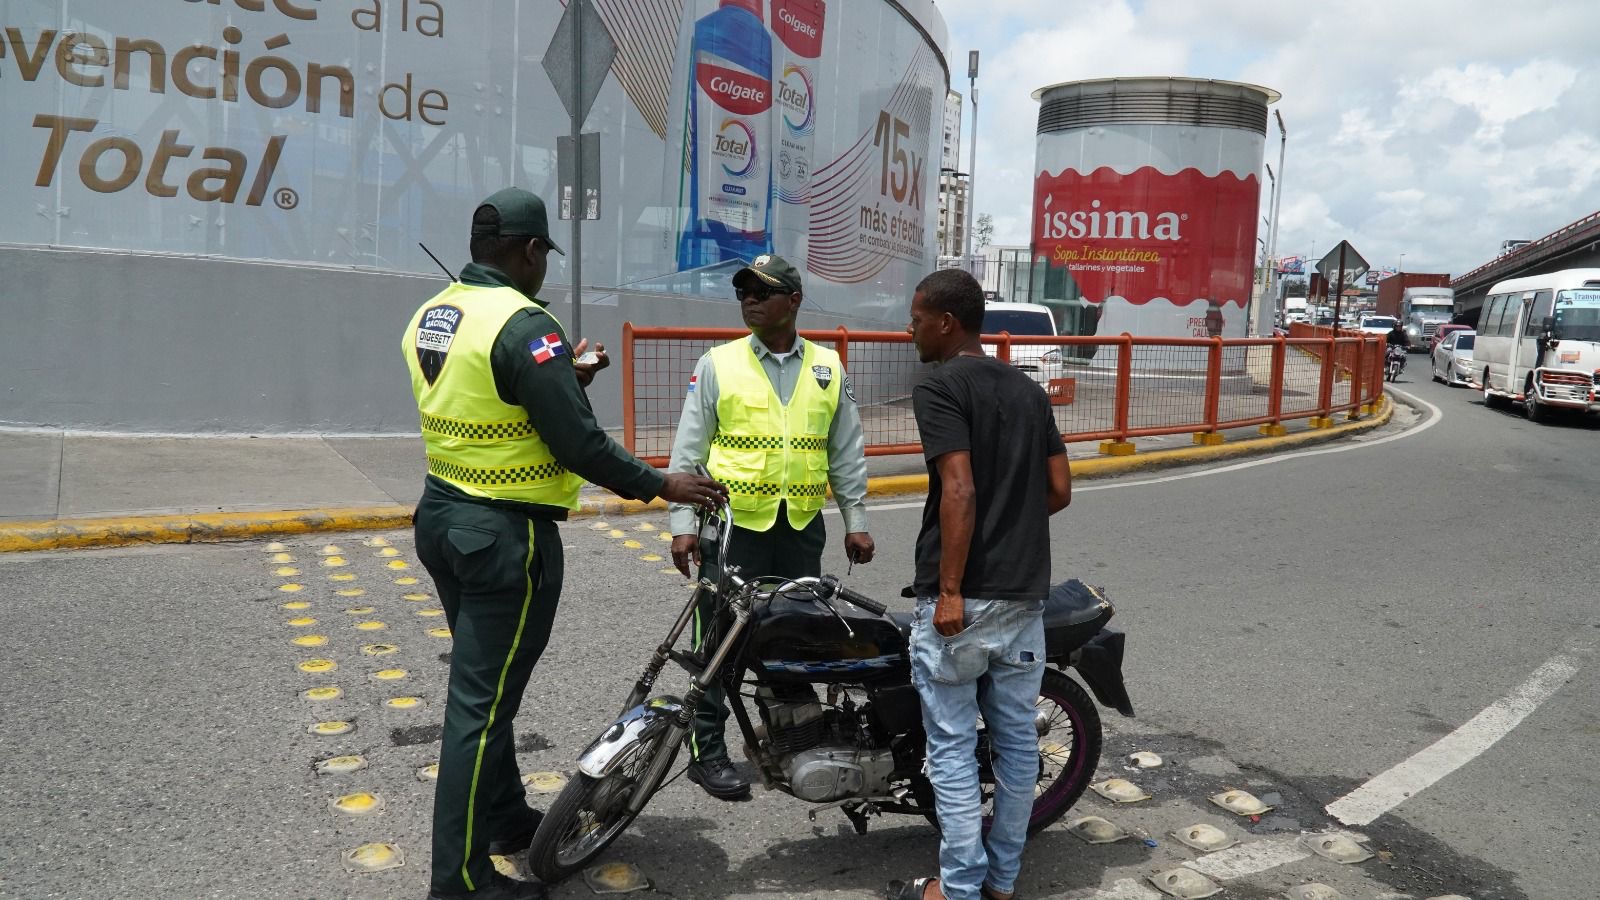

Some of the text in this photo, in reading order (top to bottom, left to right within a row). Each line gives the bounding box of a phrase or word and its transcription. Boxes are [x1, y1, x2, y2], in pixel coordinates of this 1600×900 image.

[401, 0, 444, 38] la
[778, 8, 817, 39] Colgate
[0, 26, 449, 126] vención de
[710, 76, 765, 103] Colgate
[778, 80, 808, 109] Total
[716, 134, 749, 156] Total
[860, 202, 888, 234] más
[1053, 244, 1161, 264] Sopa Instantánea
[1068, 263, 1100, 271] tallarines
[1106, 264, 1145, 274] vegetales
[420, 331, 452, 345] DIGESETT
[425, 319, 453, 333] NACIONAL
